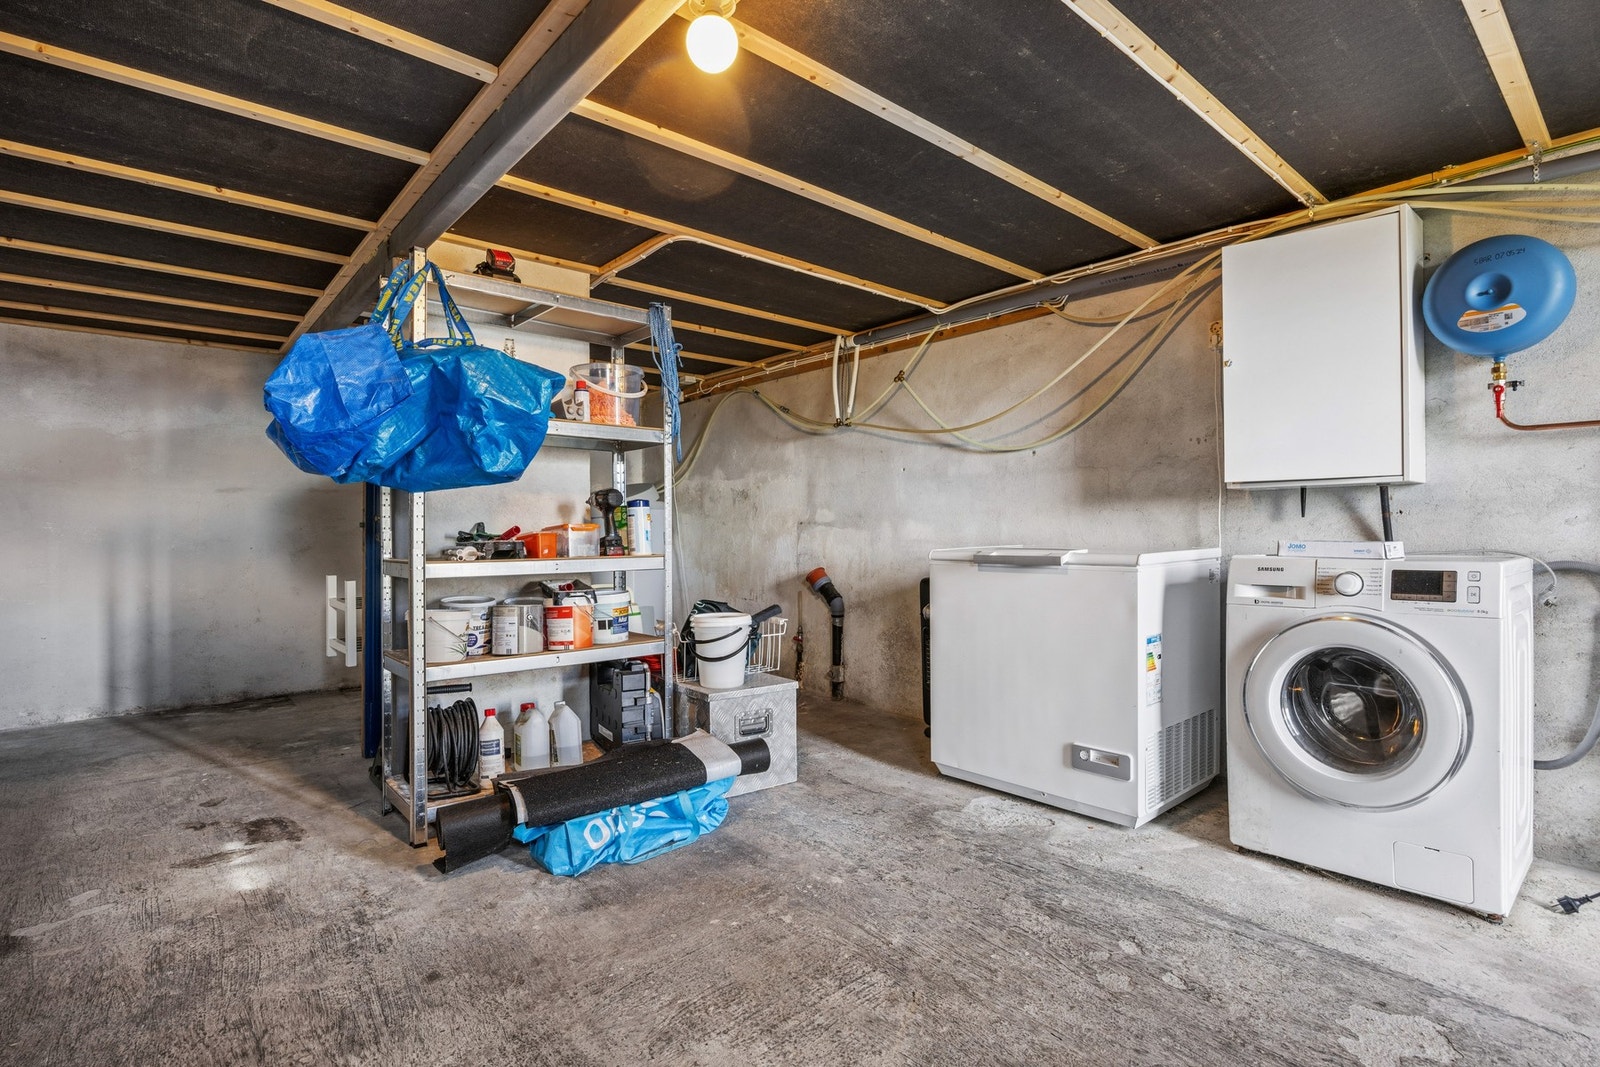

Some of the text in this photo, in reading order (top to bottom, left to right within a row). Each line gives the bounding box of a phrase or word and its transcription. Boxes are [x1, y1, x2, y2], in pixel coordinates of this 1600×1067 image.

[403, 269, 428, 302] IKEA
[447, 299, 462, 323] IKEA
[432, 338, 462, 347] IKEA
